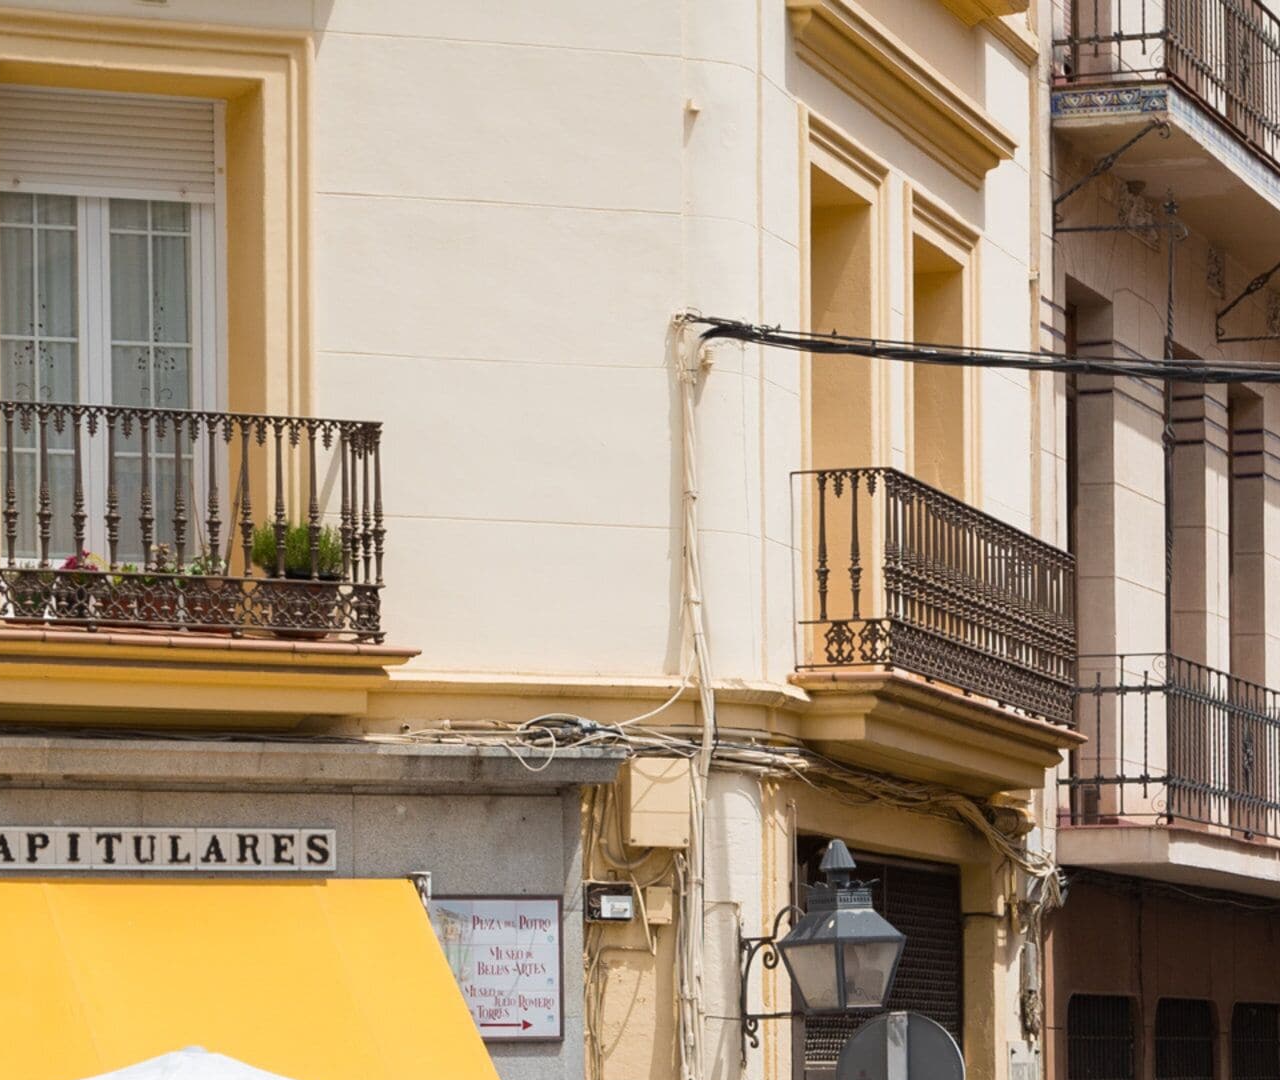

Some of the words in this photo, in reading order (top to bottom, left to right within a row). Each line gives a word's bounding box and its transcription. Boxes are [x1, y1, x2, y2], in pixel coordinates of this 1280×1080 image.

[519, 914, 552, 932] POTRO
[489, 946, 524, 961] MUSEO
[476, 1004, 510, 1020] TORRES
